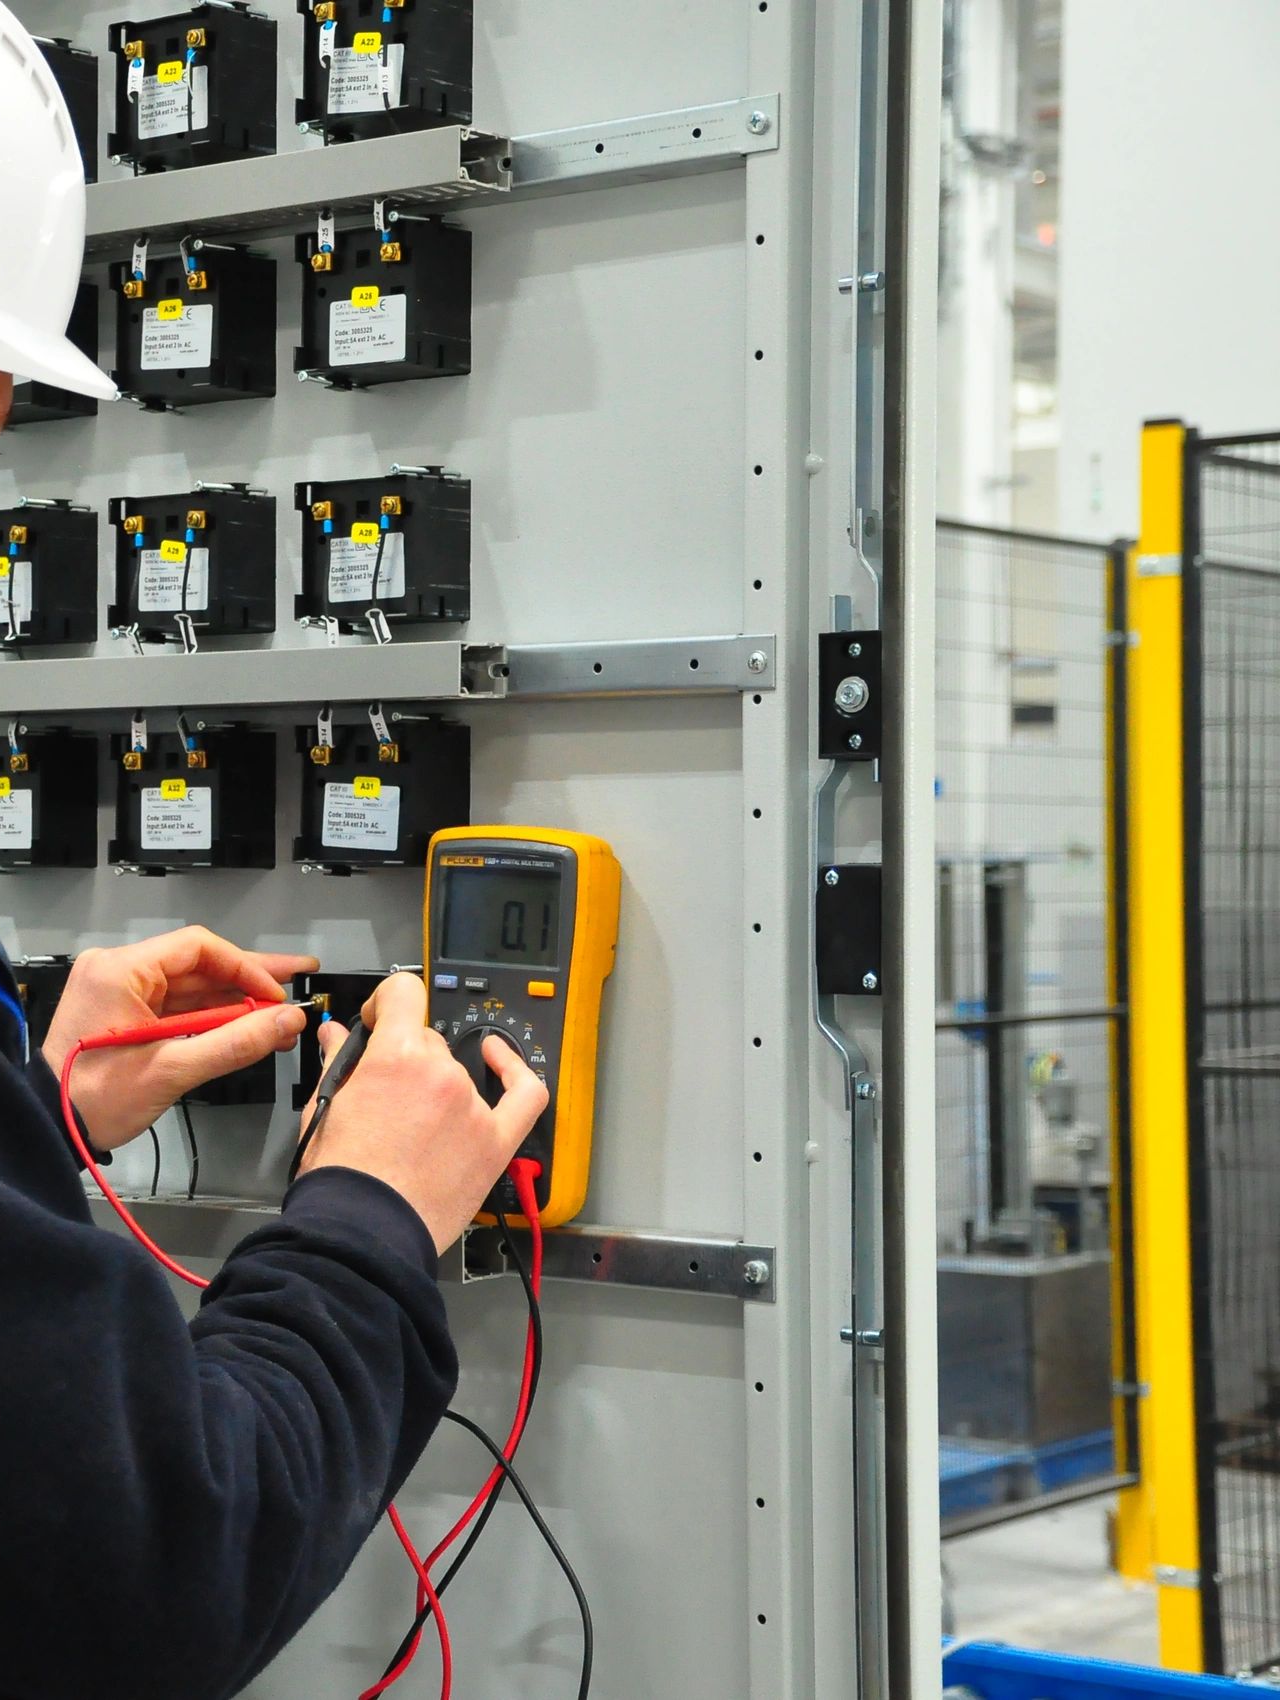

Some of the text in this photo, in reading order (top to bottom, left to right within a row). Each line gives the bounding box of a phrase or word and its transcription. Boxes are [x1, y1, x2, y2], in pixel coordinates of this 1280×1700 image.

[360, 38, 375, 46] A22
[164, 68, 177, 76] A23
[360, 783, 374, 791] A31
[446, 857, 479, 865] FLUKE
[500, 858, 520, 866] DIGITAL
[465, 980, 484, 989] RANGE
[530, 1054, 547, 1064] mA
